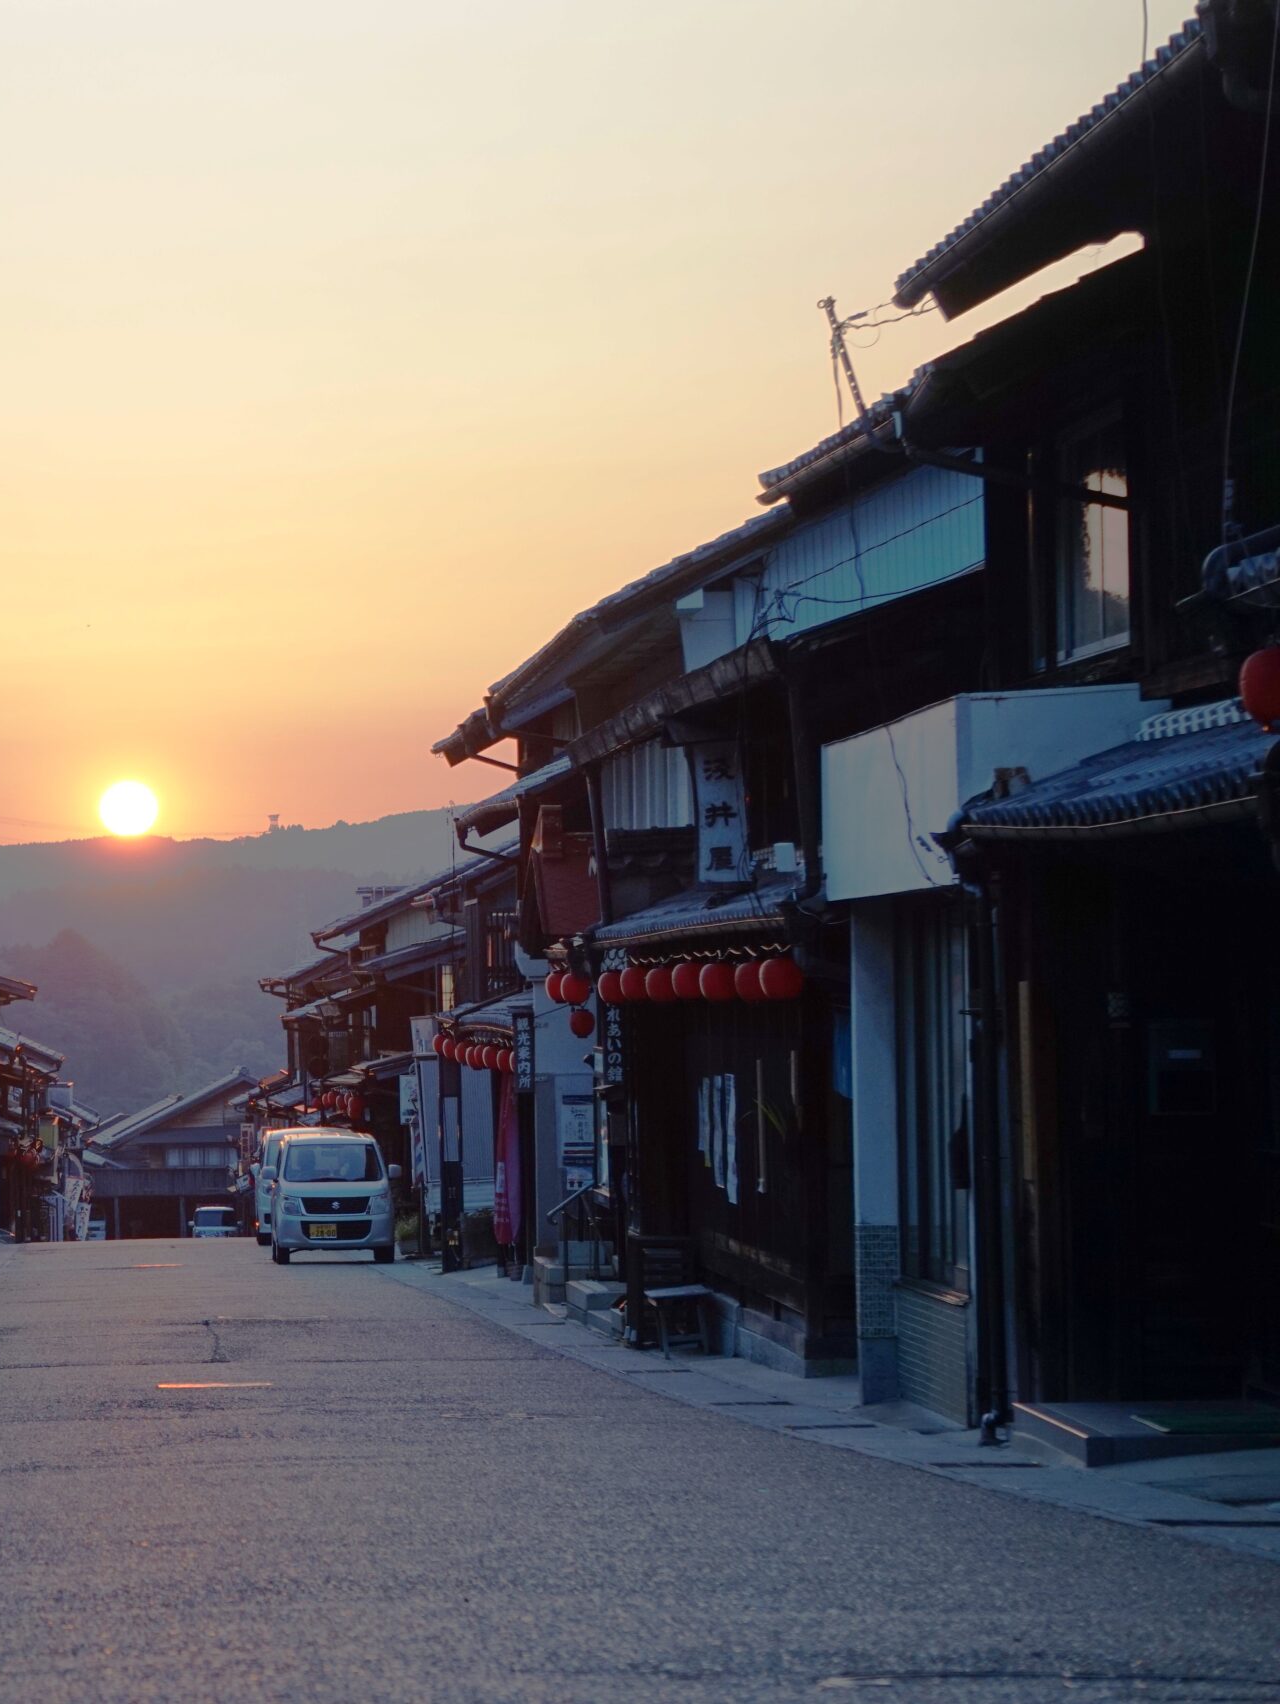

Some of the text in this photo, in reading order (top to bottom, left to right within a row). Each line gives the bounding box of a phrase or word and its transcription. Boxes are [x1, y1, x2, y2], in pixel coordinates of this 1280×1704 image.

[516, 1018, 531, 1089] 観光案内所
